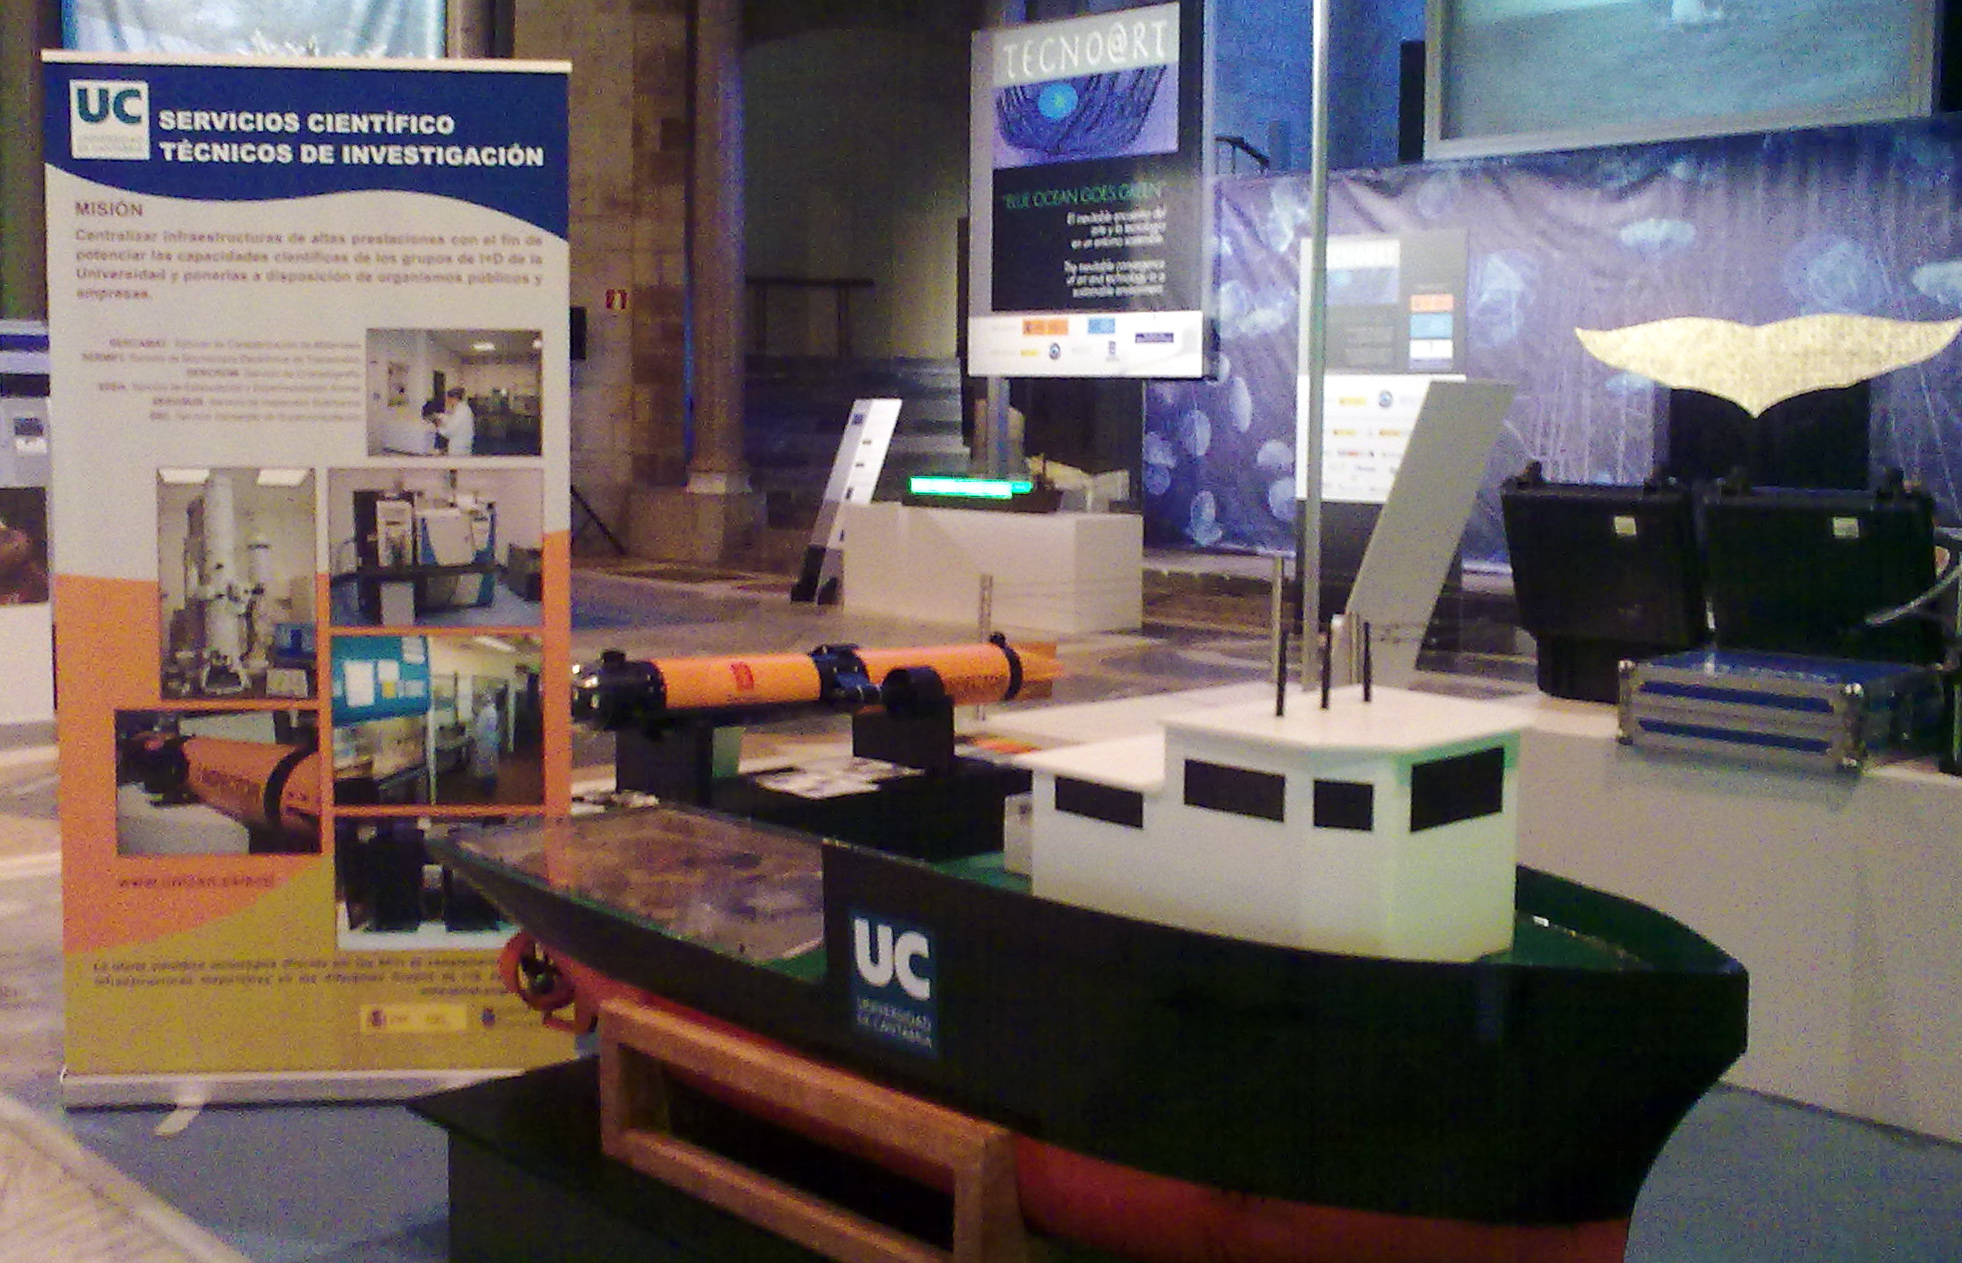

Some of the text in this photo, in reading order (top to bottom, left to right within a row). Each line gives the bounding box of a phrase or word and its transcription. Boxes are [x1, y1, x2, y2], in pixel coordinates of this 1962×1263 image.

[1003, 19, 1168, 79] TECNO@RT
[76, 88, 142, 124] UC
[158, 109, 455, 135] SERVICIOS CIENTÍFICO
[158, 139, 293, 163] TÉCNICOS
[300, 143, 334, 164] DE
[341, 142, 544, 167] INVESTIGACIÓN
[75, 201, 143, 217] MISIÓN
[288, 231, 305, 243] de
[311, 232, 346, 245] altas
[451, 235, 478, 246] con
[482, 234, 496, 246] el
[524, 234, 543, 247] de
[75, 250, 146, 263] potenciar
[151, 250, 172, 262] las
[354, 252, 371, 264] de
[375, 252, 397, 264] los
[402, 253, 452, 267] grupos
[457, 253, 475, 265] de
[508, 254, 525, 266] de
[76, 268, 166, 281] Universidad
[356, 271, 372, 283] de
[854, 918, 931, 1001] UC
